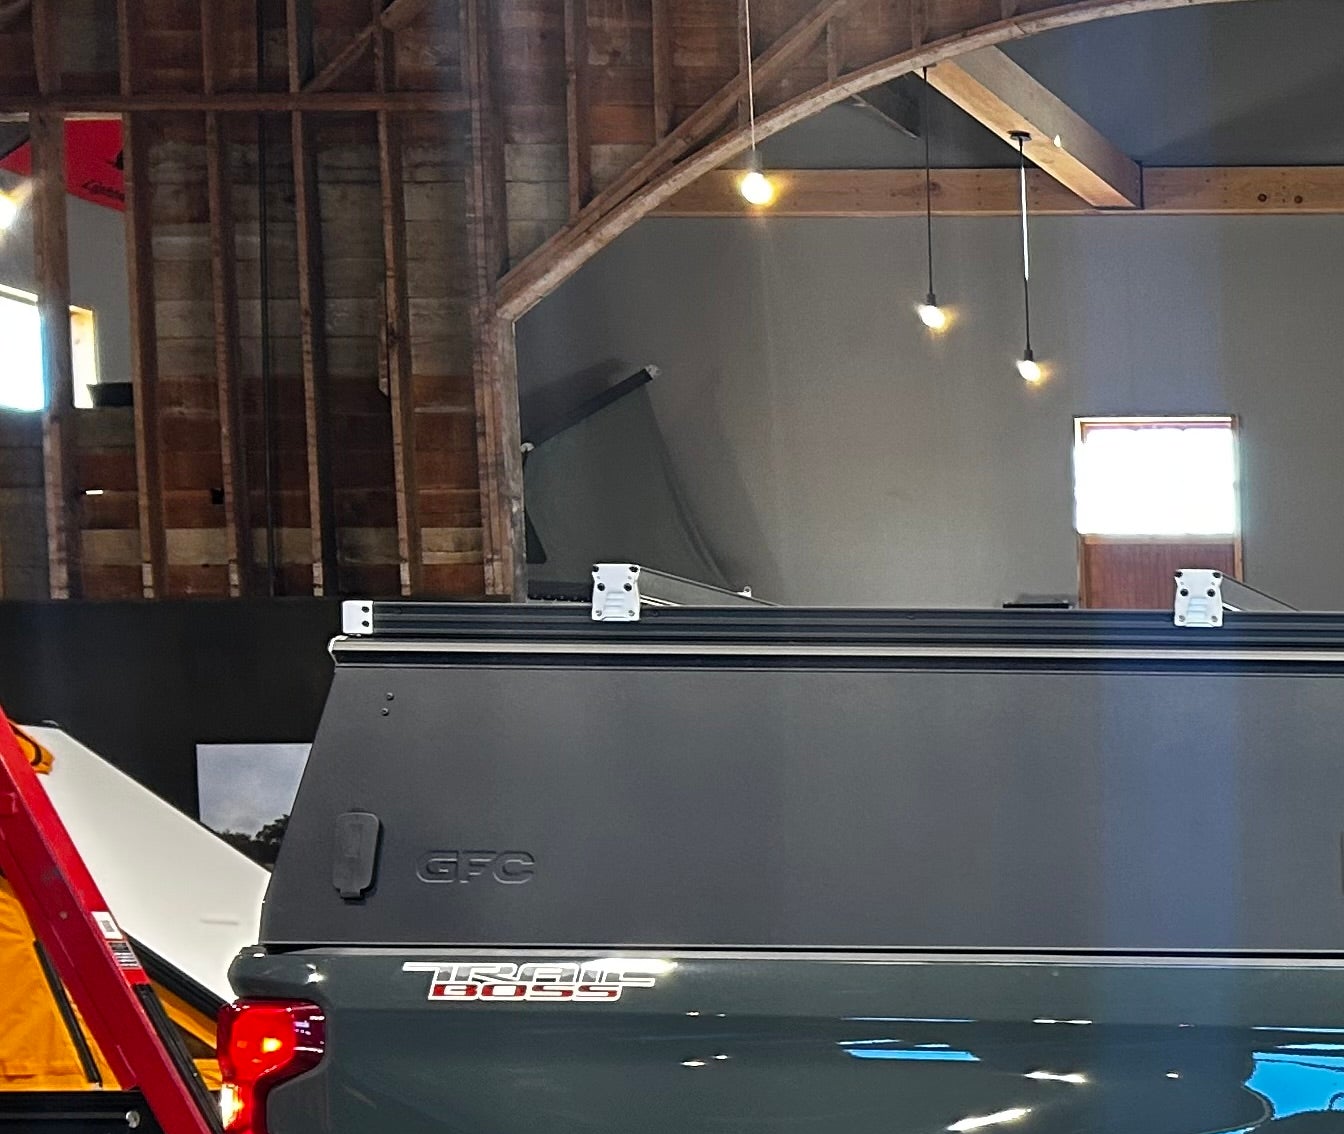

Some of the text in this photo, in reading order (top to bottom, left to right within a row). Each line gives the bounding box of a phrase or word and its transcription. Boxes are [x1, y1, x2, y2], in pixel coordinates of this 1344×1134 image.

[415, 848, 536, 885] GFC
[401, 960, 658, 987] TRAIL
[428, 982, 624, 1002] BOSS
